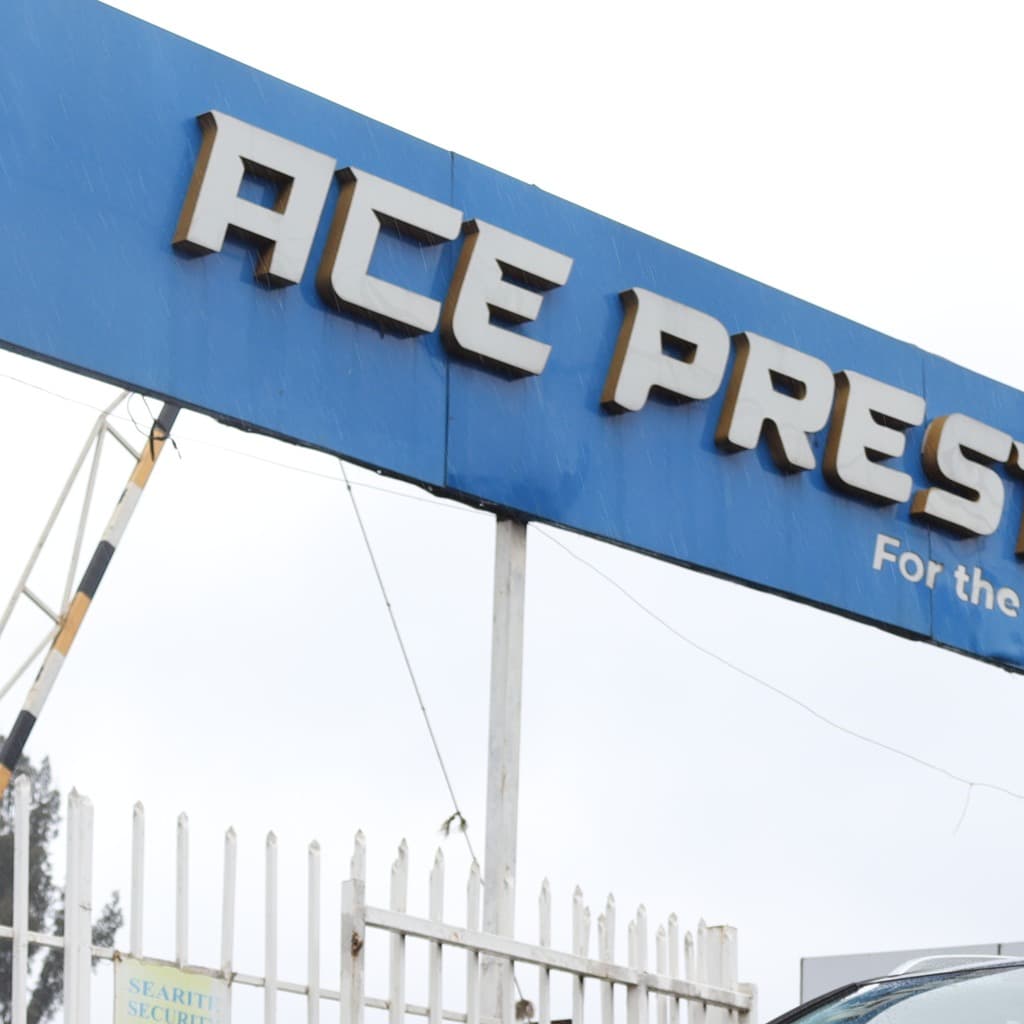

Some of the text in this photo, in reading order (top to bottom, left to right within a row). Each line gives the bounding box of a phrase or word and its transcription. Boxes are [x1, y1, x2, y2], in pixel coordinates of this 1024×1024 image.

[172, 109, 574, 377] ACE
[872, 533, 944, 590] For
[954, 564, 1020, 618] the
